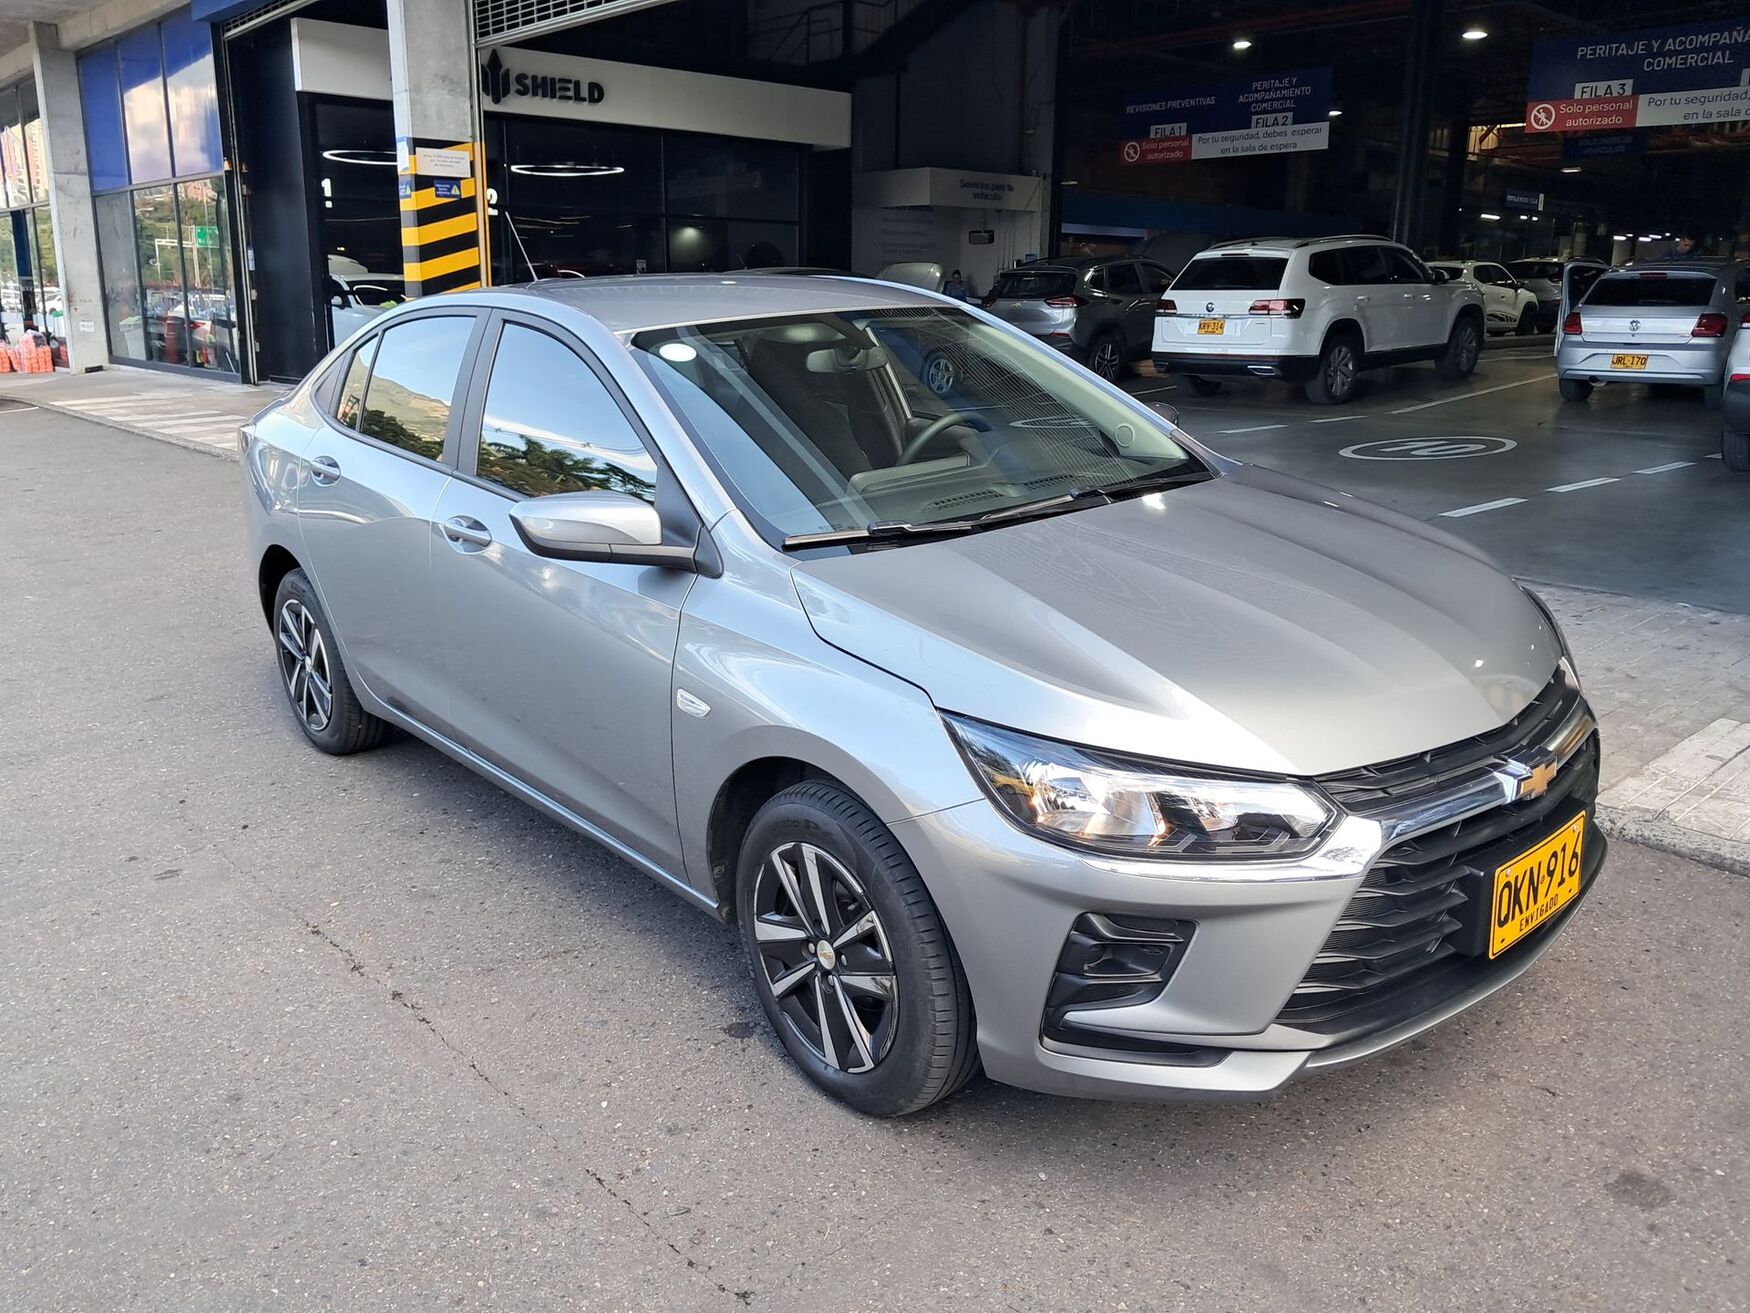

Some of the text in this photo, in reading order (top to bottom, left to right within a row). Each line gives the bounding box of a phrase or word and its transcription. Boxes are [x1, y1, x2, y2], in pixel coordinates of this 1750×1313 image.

[1577, 41, 1648, 59] PERITAJE
[1652, 39, 1661, 52] Y
[1644, 50, 1735, 71] COMERCIAL
[514, 72, 605, 104] SHIELD
[1252, 76, 1298, 91] PERITAJE Y
[1581, 82, 1627, 98] FILA 3
[1238, 86, 1312, 103] ACOMPAÑAMIENTO
[1648, 96, 1667, 107] Por
[1669, 95, 1681, 106] tu
[1126, 96, 1216, 114] REVISIONES PREVENTIVAS
[1251, 99, 1297, 113] COMERCIAL
[1559, 100, 1633, 115] Solo personal
[1565, 115, 1623, 127] autorizado
[1683, 111, 1699, 120] en
[1702, 109, 1713, 119] la
[1715, 107, 1741, 118] sala
[1255, 115, 1289, 128] FILA 2
[1198, 134, 1211, 144] Por
[1262, 129, 1287, 139] debes
[1291, 126, 1323, 138] esperar
[1142, 138, 1189, 150] Solo personal
[1220, 145, 1231, 154] en
[1241, 143, 1256, 153] sala
[1258, 141, 1268, 151] de
[1270, 142, 1297, 153] espera
[959, 179, 989, 190] Servicios
[1519, 893, 1559, 932] ENVIGADO
